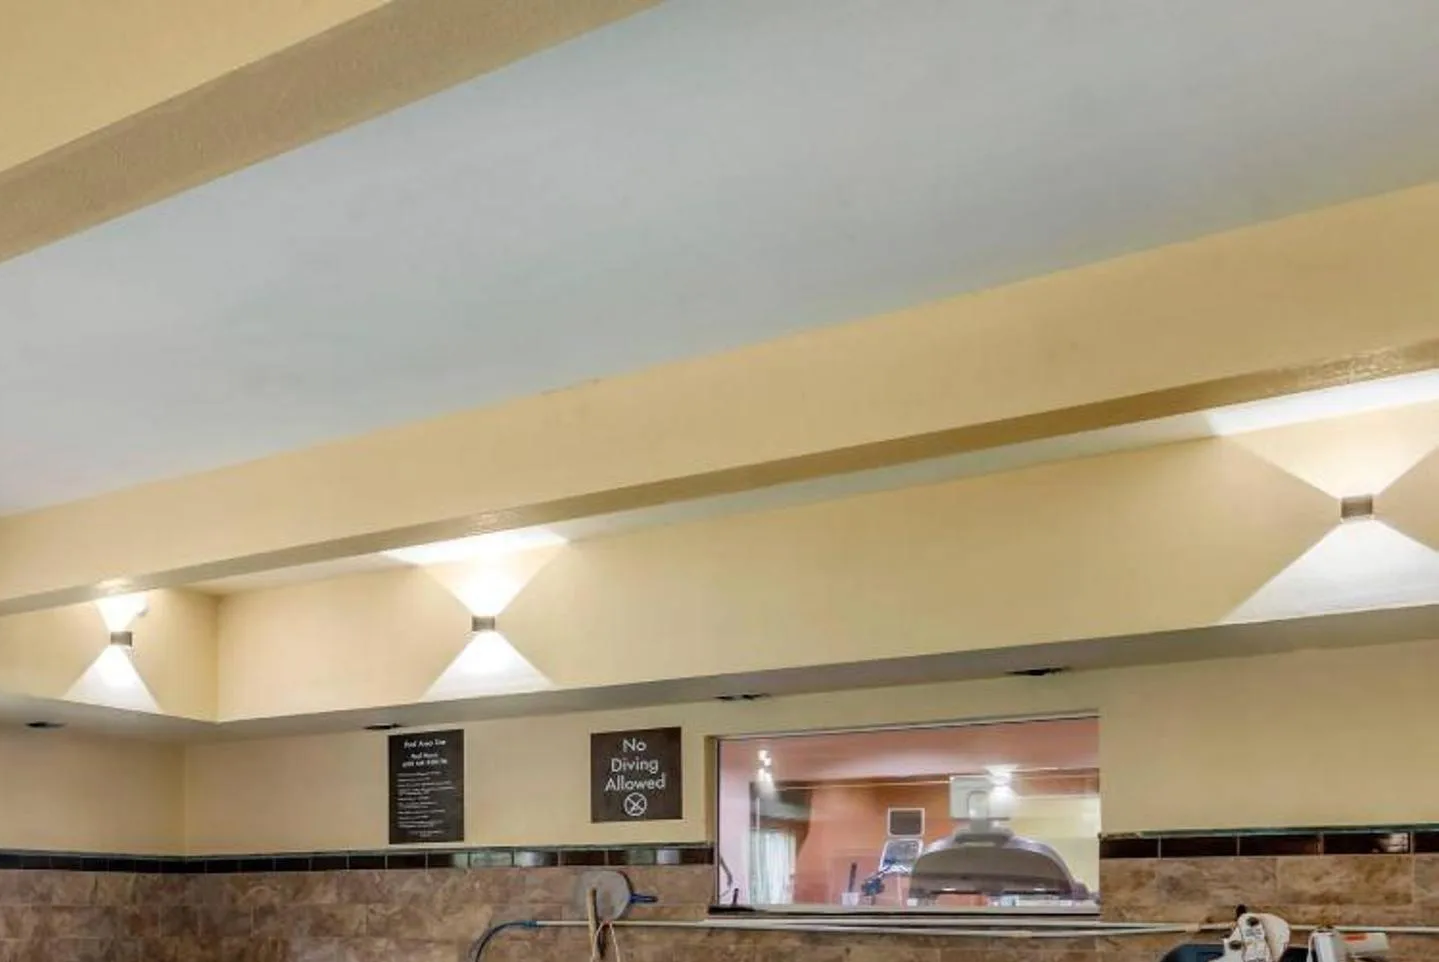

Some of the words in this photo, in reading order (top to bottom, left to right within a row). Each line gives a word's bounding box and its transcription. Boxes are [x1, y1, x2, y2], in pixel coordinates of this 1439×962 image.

[622, 738, 647, 752] No
[611, 756, 659, 774] Diving
[604, 772, 666, 792] Allowed
